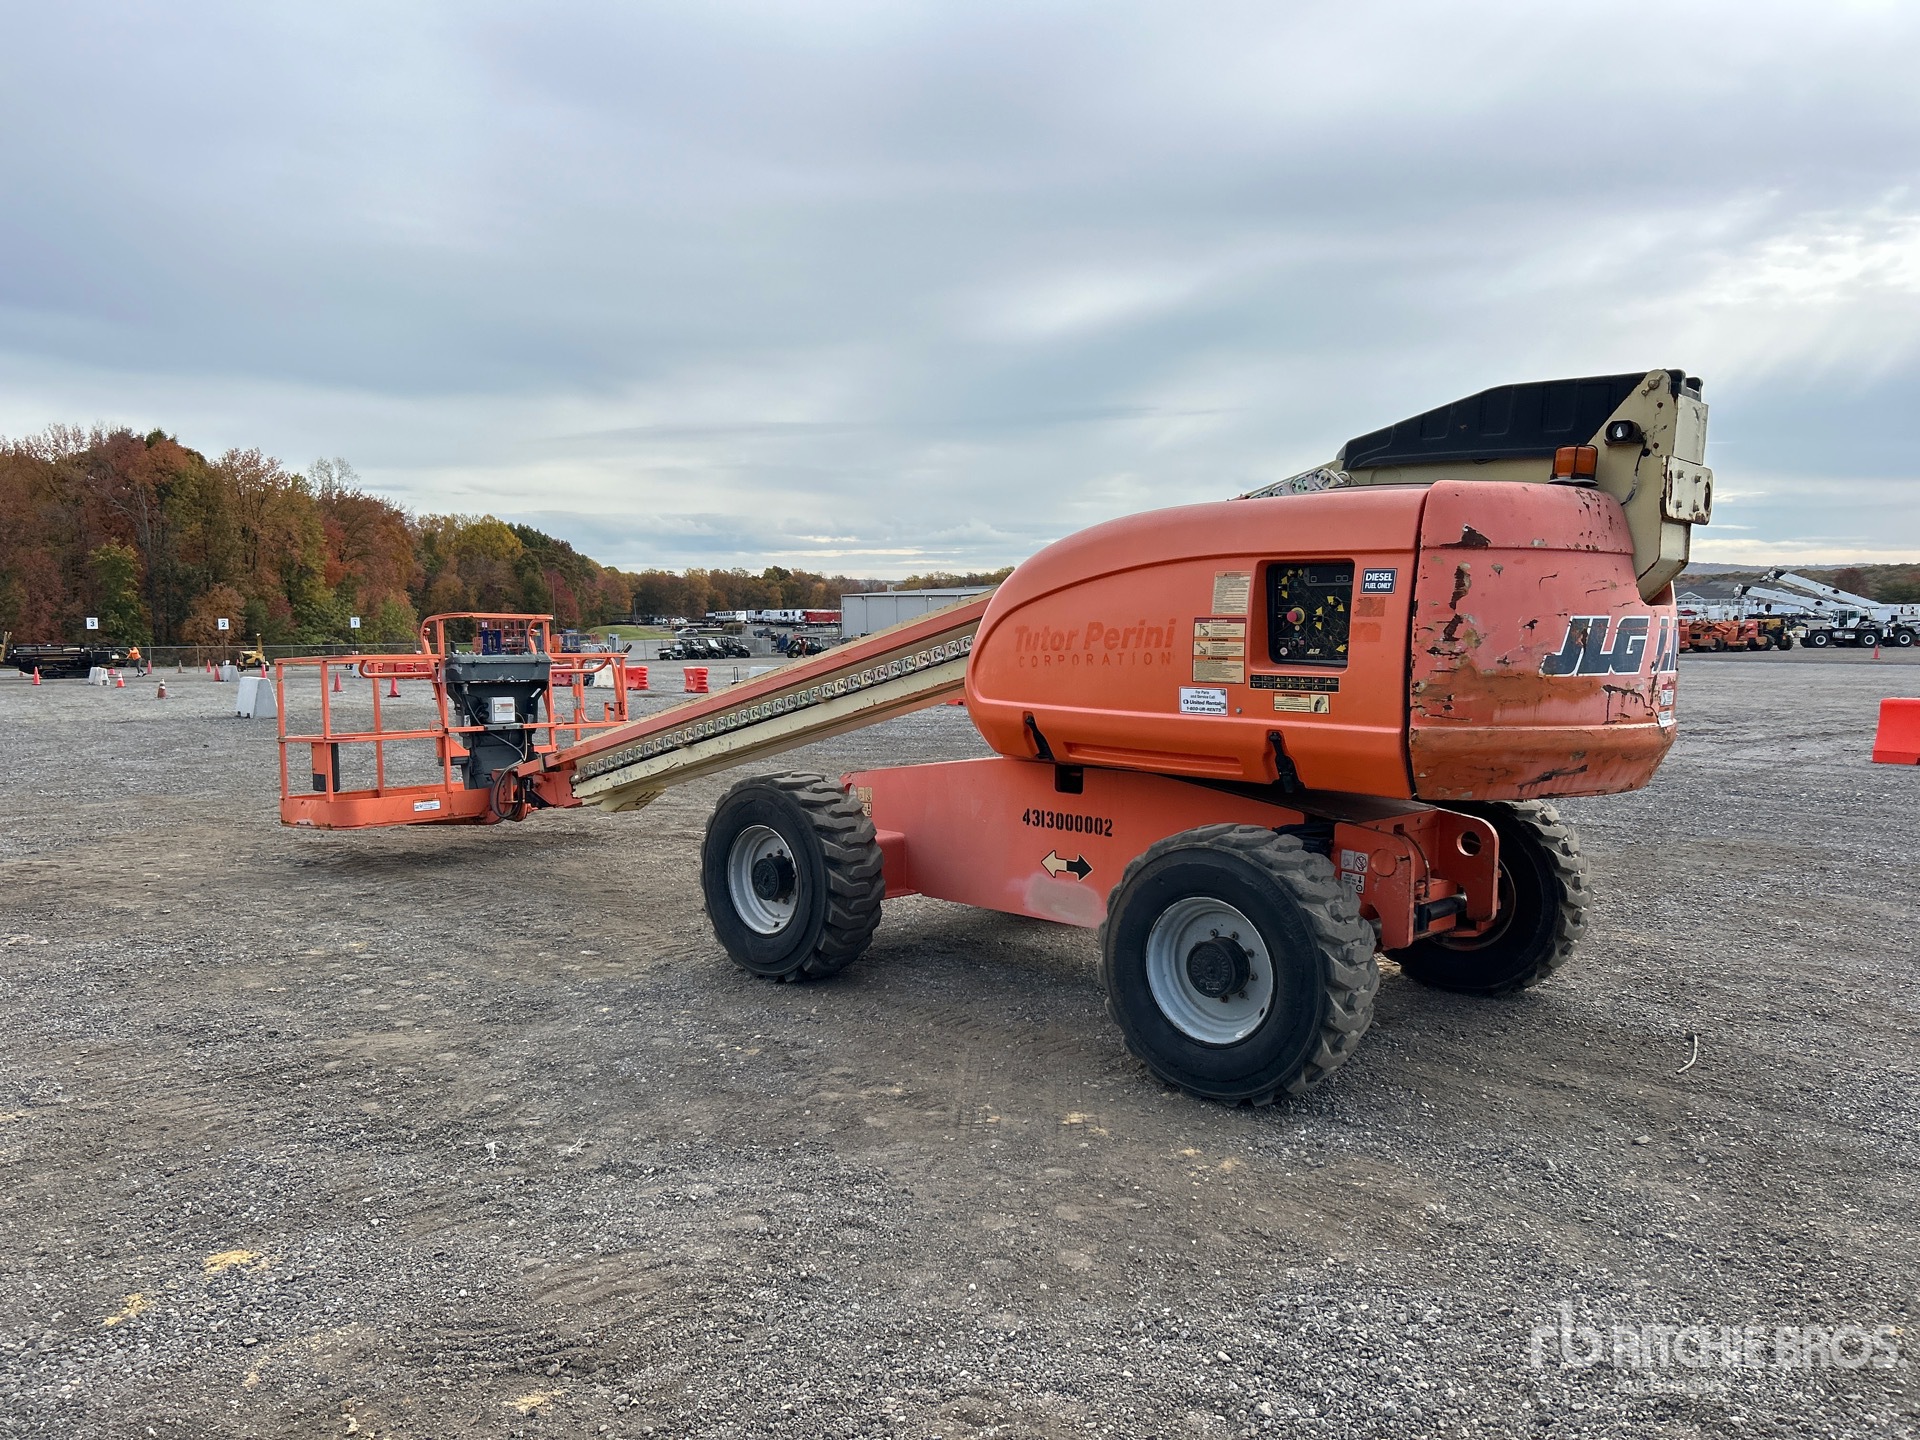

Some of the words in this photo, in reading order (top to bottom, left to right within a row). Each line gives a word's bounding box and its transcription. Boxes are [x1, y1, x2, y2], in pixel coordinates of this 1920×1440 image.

[1365, 572, 1393, 581] DIESEL
[1014, 624, 1079, 651] Tutor
[1083, 618, 1177, 650] Perini
[1539, 616, 1650, 676] JLG
[1018, 652, 1171, 668] CORPORATION
[1022, 808, 1113, 837] 4313000002
